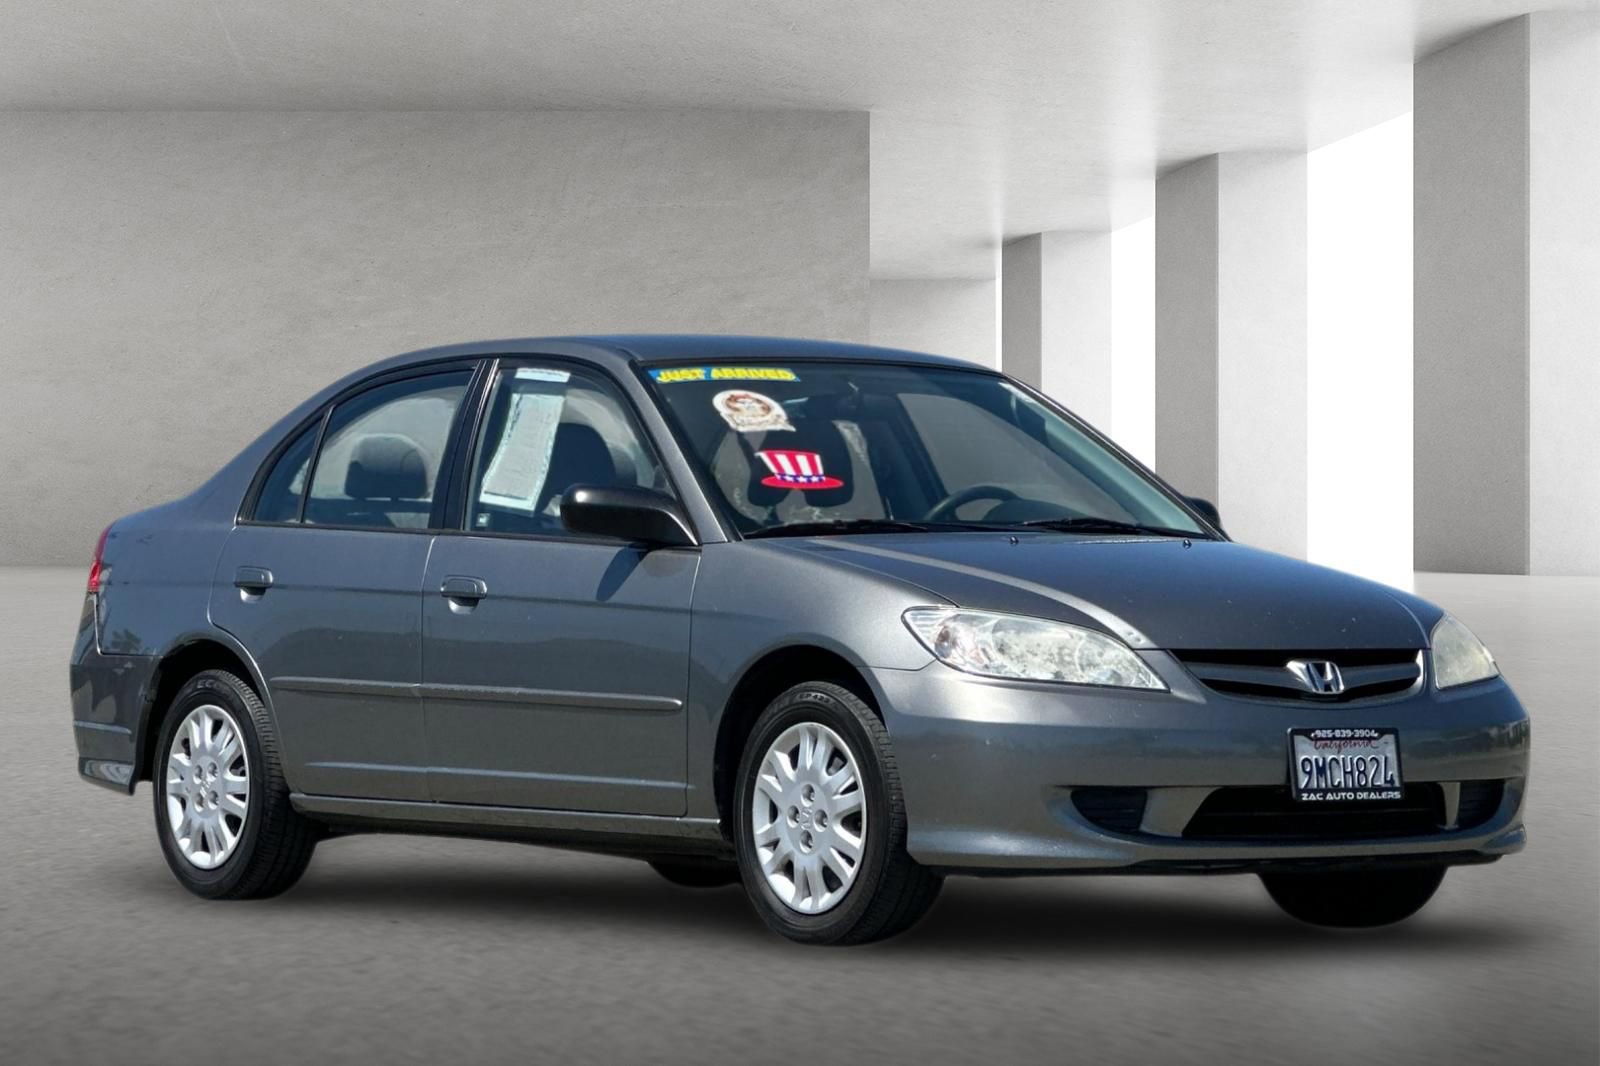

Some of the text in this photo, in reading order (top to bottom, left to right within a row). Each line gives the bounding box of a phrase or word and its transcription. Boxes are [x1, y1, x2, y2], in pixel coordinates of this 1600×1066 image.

[1300, 755, 1395, 788] 9MCH824
[1301, 791, 1401, 801] ZAC AUTO DEALERS
